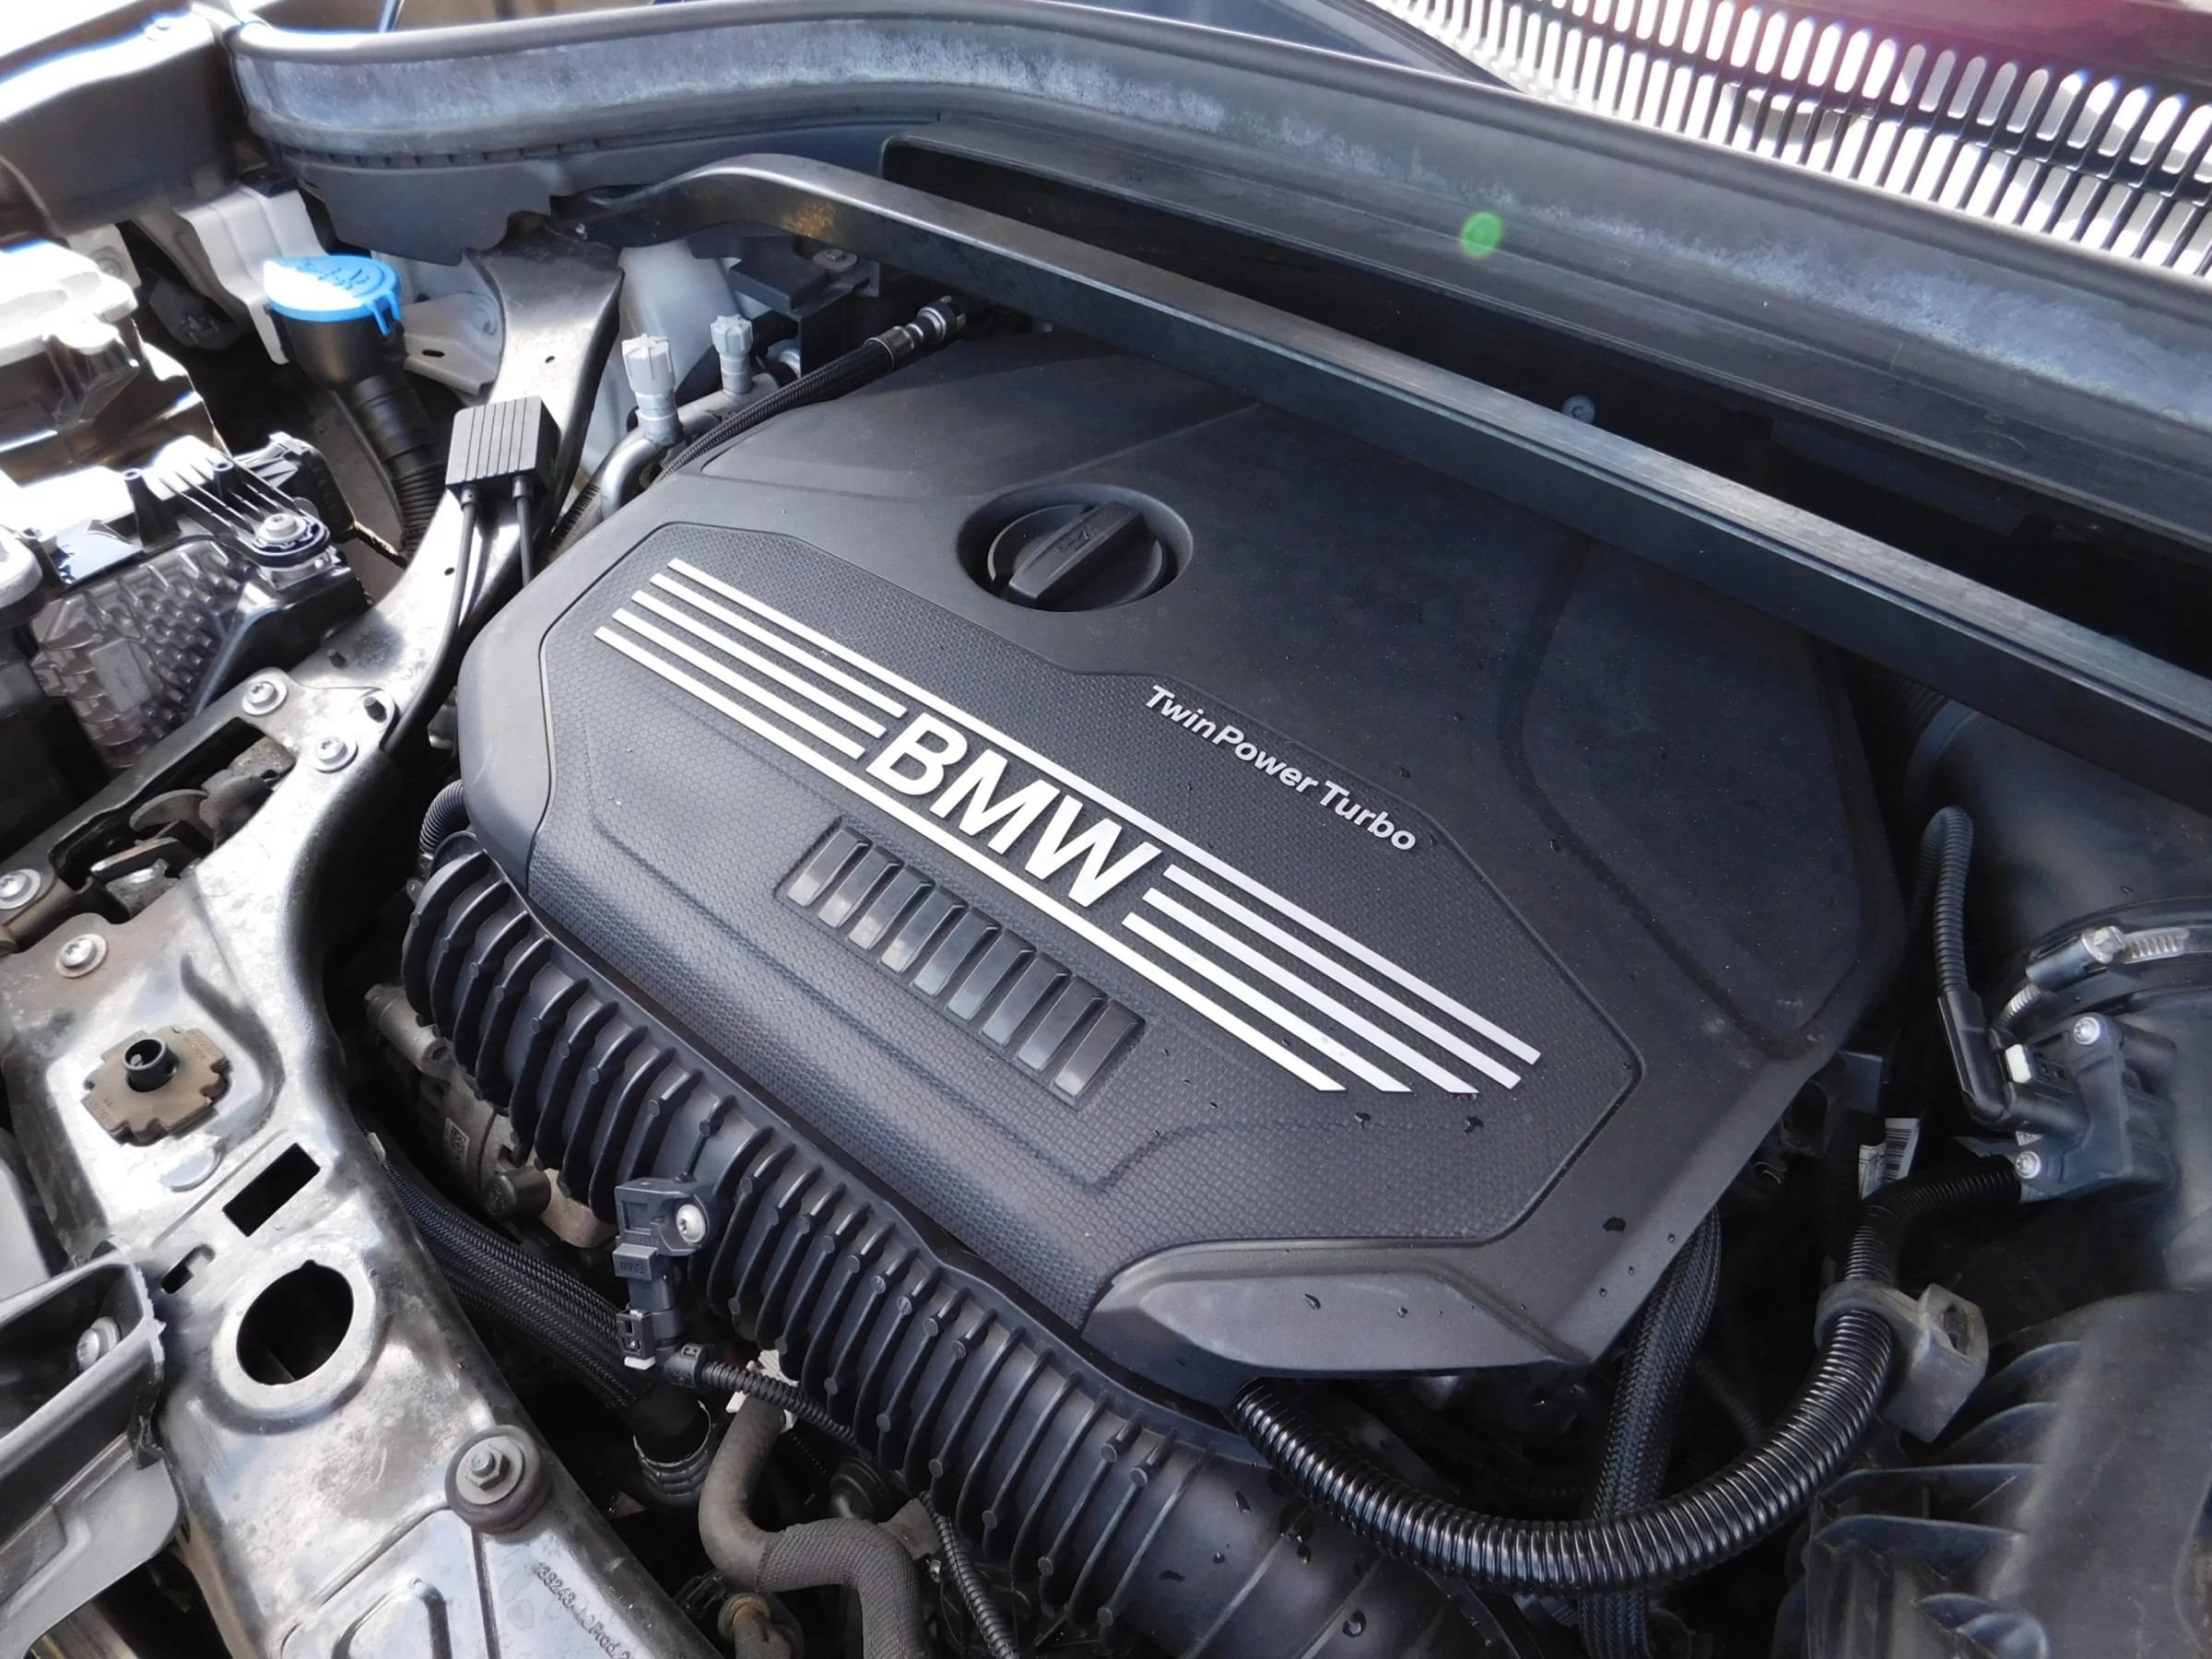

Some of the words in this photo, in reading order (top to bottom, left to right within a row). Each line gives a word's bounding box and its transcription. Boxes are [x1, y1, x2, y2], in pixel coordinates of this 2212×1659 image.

[865, 712, 1162, 908] BMW
[1144, 685, 1319, 794] TwinPower
[1318, 780, 1417, 851] Turbo
